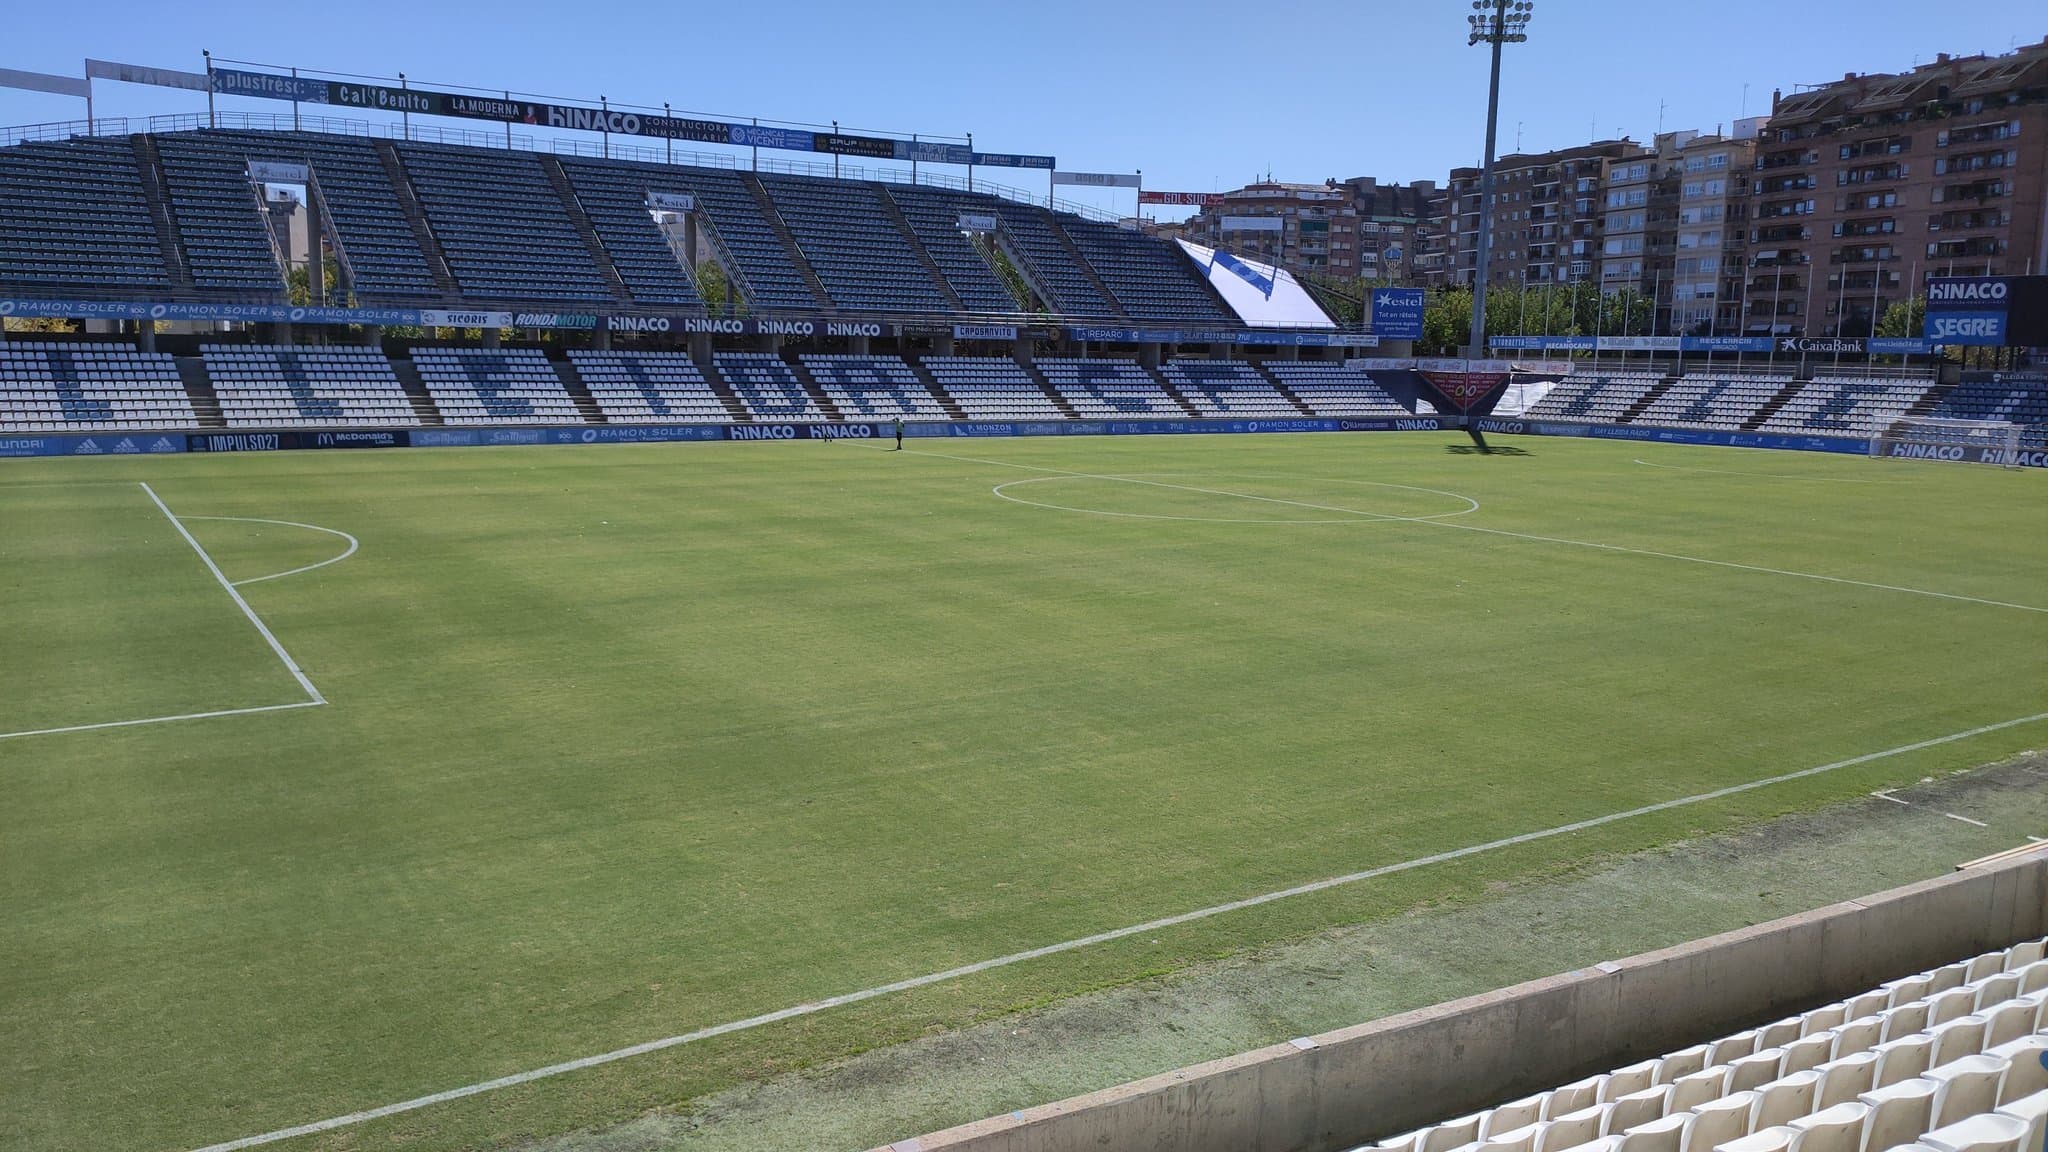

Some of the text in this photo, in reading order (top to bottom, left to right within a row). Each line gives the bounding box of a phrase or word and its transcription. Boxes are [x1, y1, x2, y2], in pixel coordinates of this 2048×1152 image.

[339, 85, 366, 104] Cal
[379, 89, 429, 111] Benito
[452, 99, 466, 110] LA
[468, 100, 520, 116] MODERNA
[548, 106, 640, 134] HINACO
[644, 116, 729, 132] CONSTRUCTORA
[644, 127, 729, 143] INMOBILIARIA
[747, 135, 785, 147] VICENTE
[1163, 193, 1207, 205] GOL-SUD
[1929, 282, 2007, 299] HINACO
[18, 302, 73, 312] RAMON
[78, 303, 126, 313] SOLER
[1391, 295, 1422, 306] estel
[169, 305, 217, 314] RAMON
[223, 306, 268, 315] SOLER
[308, 308, 353, 318] RAMON
[357, 310, 399, 320] SOLER
[608, 317, 670, 332] HINACO
[685, 319, 743, 333] HINACO
[758, 320, 814, 335] HINACO
[828, 322, 881, 337] HINACO
[1930, 318, 1999, 339] SEGRE
[1799, 338, 1862, 352] CaixaBank
[810, 424, 871, 439] HINACO
[1259, 421, 1289, 429] RAMON
[1291, 420, 1319, 428] SOLER
[1396, 418, 1439, 431] HINACO
[1477, 420, 1523, 433] HINACO
[336, 431, 394, 441] McDonald's
[600, 428, 648, 438] RAMON
[652, 427, 694, 437] SOLER
[730, 425, 796, 440] HINACO
[1892, 443, 1965, 460] HINACO
